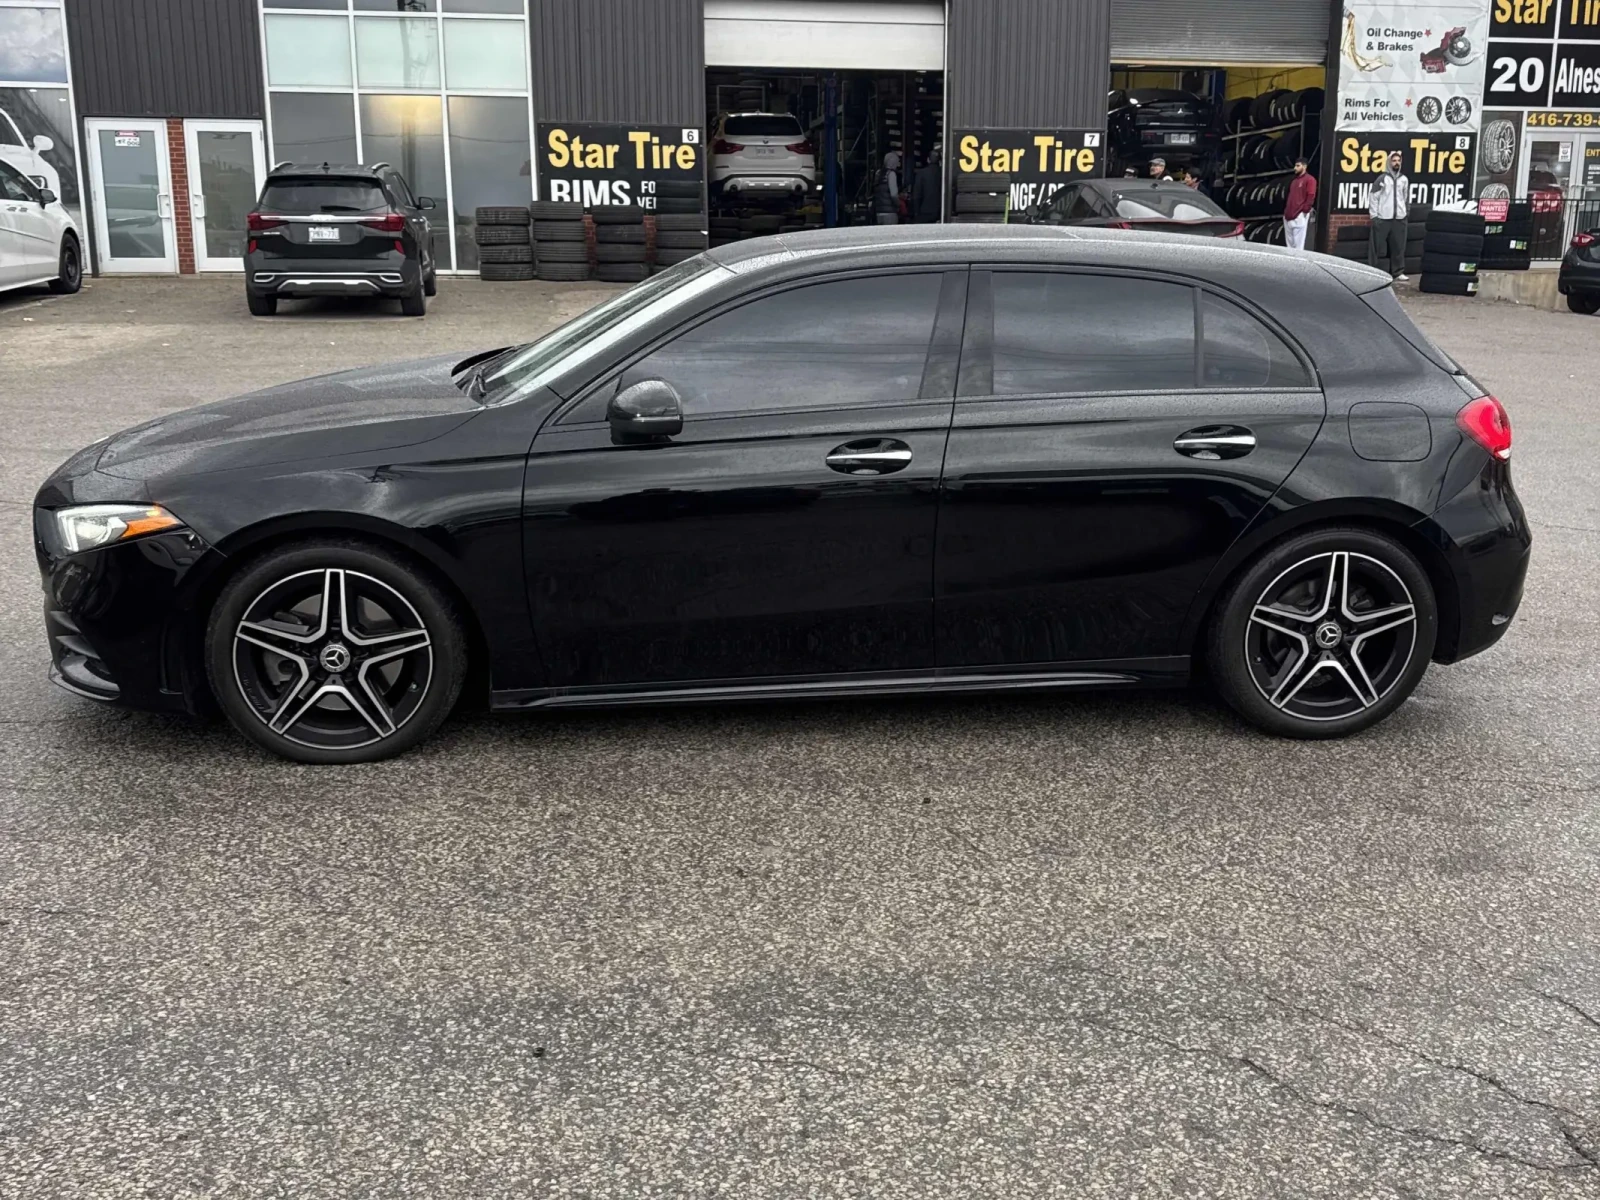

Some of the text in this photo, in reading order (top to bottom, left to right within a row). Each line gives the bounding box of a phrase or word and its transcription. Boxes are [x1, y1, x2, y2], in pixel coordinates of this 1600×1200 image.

[1366, 28, 1423, 40] Oil Change
[1366, 41, 1414, 51] & Brakes
[1489, 56, 1600, 94] 20 Alnes
[1344, 98, 1391, 107] Rims For
[1343, 112, 1404, 121] All Vehicles
[1527, 112, 1600, 127] 416-739-
[686, 130, 695, 142] 6
[1088, 134, 1096, 145] 7
[548, 128, 696, 170] Star Tire
[1459, 138, 1466, 148] 8
[959, 134, 1095, 173] Star Tire
[1340, 137, 1466, 174] Sta Tire
[1586, 149, 1600, 157] ENT
[641, 180, 656, 194] FO
[550, 179, 631, 208] RIMS
